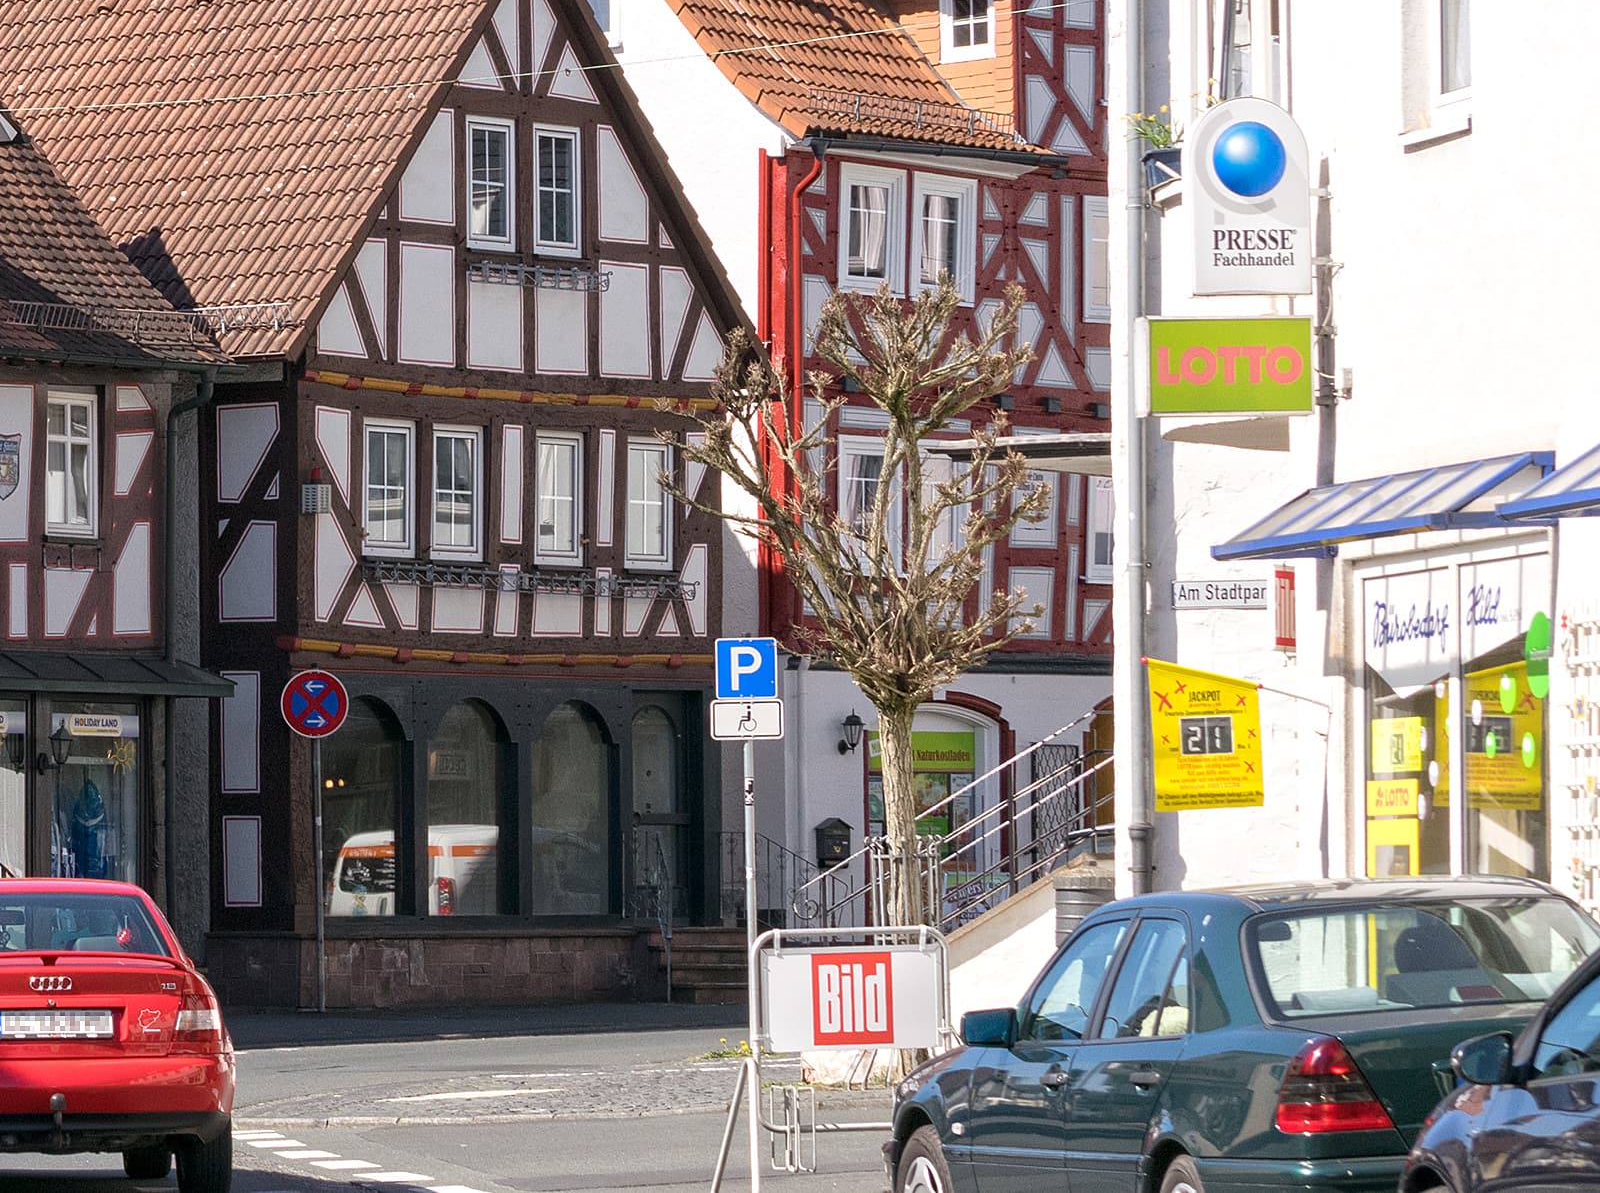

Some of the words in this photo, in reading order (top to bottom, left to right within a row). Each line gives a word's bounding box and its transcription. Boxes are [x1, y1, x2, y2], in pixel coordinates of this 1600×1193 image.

[1212, 229, 1294, 250] PRESSE
[1213, 252, 1295, 267] Fachhandel
[1157, 345, 1303, 385] LOTTO
[1178, 585, 1200, 601] Am
[1373, 601, 1450, 654] Bürobedarf
[1466, 584, 1501, 626] Hild
[730, 646, 763, 691] P
[1188, 690, 1221, 703] JACKPOT
[74, 717, 100, 727] HOLIDAY
[101, 718, 119, 728] LAND
[1385, 788, 1410, 807] LOTTO
[817, 961, 887, 1035] Bild
